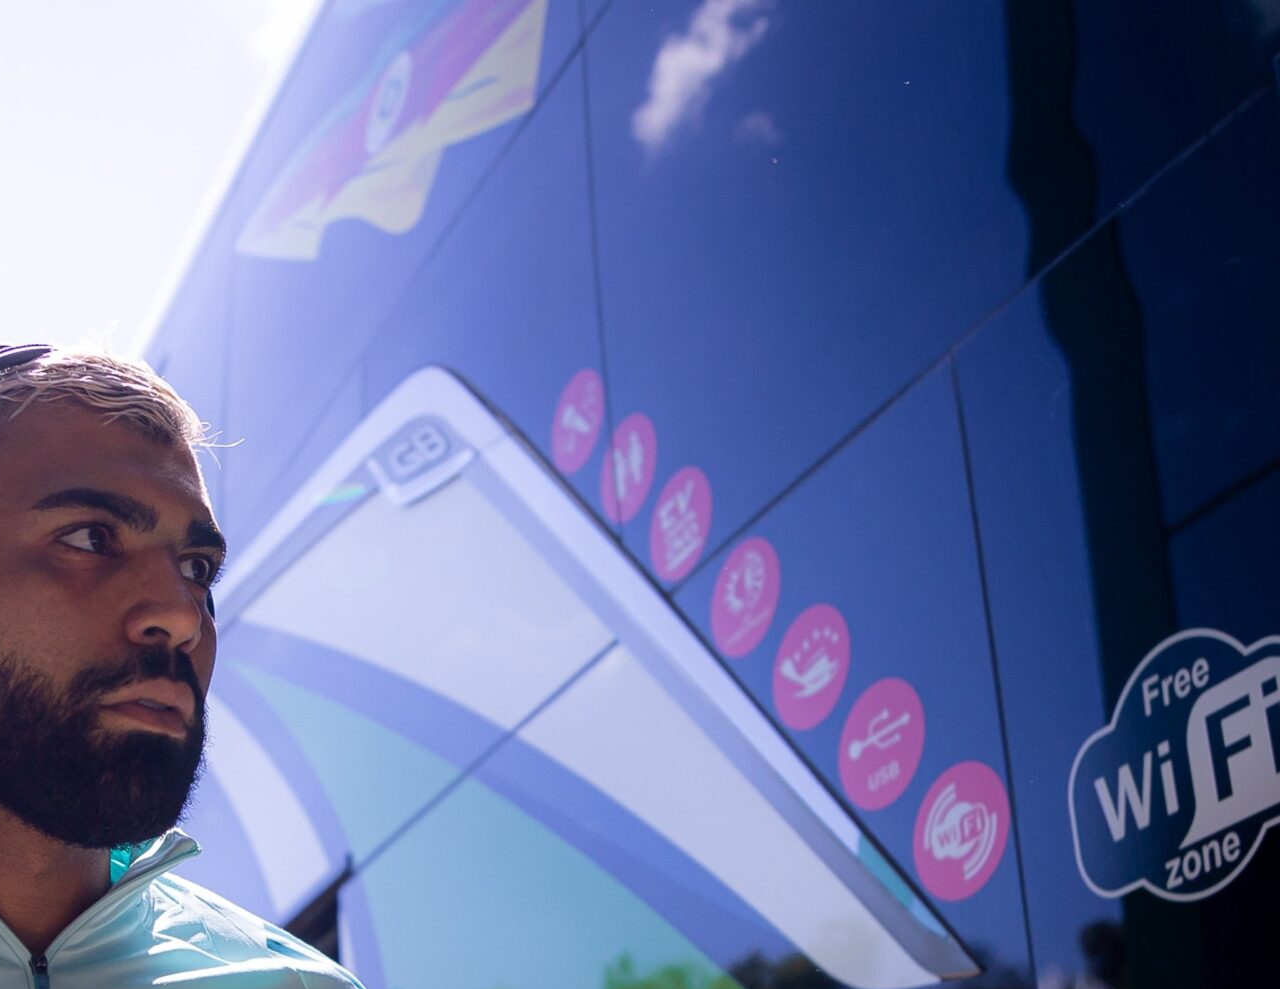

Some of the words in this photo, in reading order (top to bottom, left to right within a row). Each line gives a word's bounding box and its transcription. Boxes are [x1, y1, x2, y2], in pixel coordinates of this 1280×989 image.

[1141, 657, 1210, 717] Free
[867, 760, 901, 792] USB
[1165, 832, 1241, 889] zone
